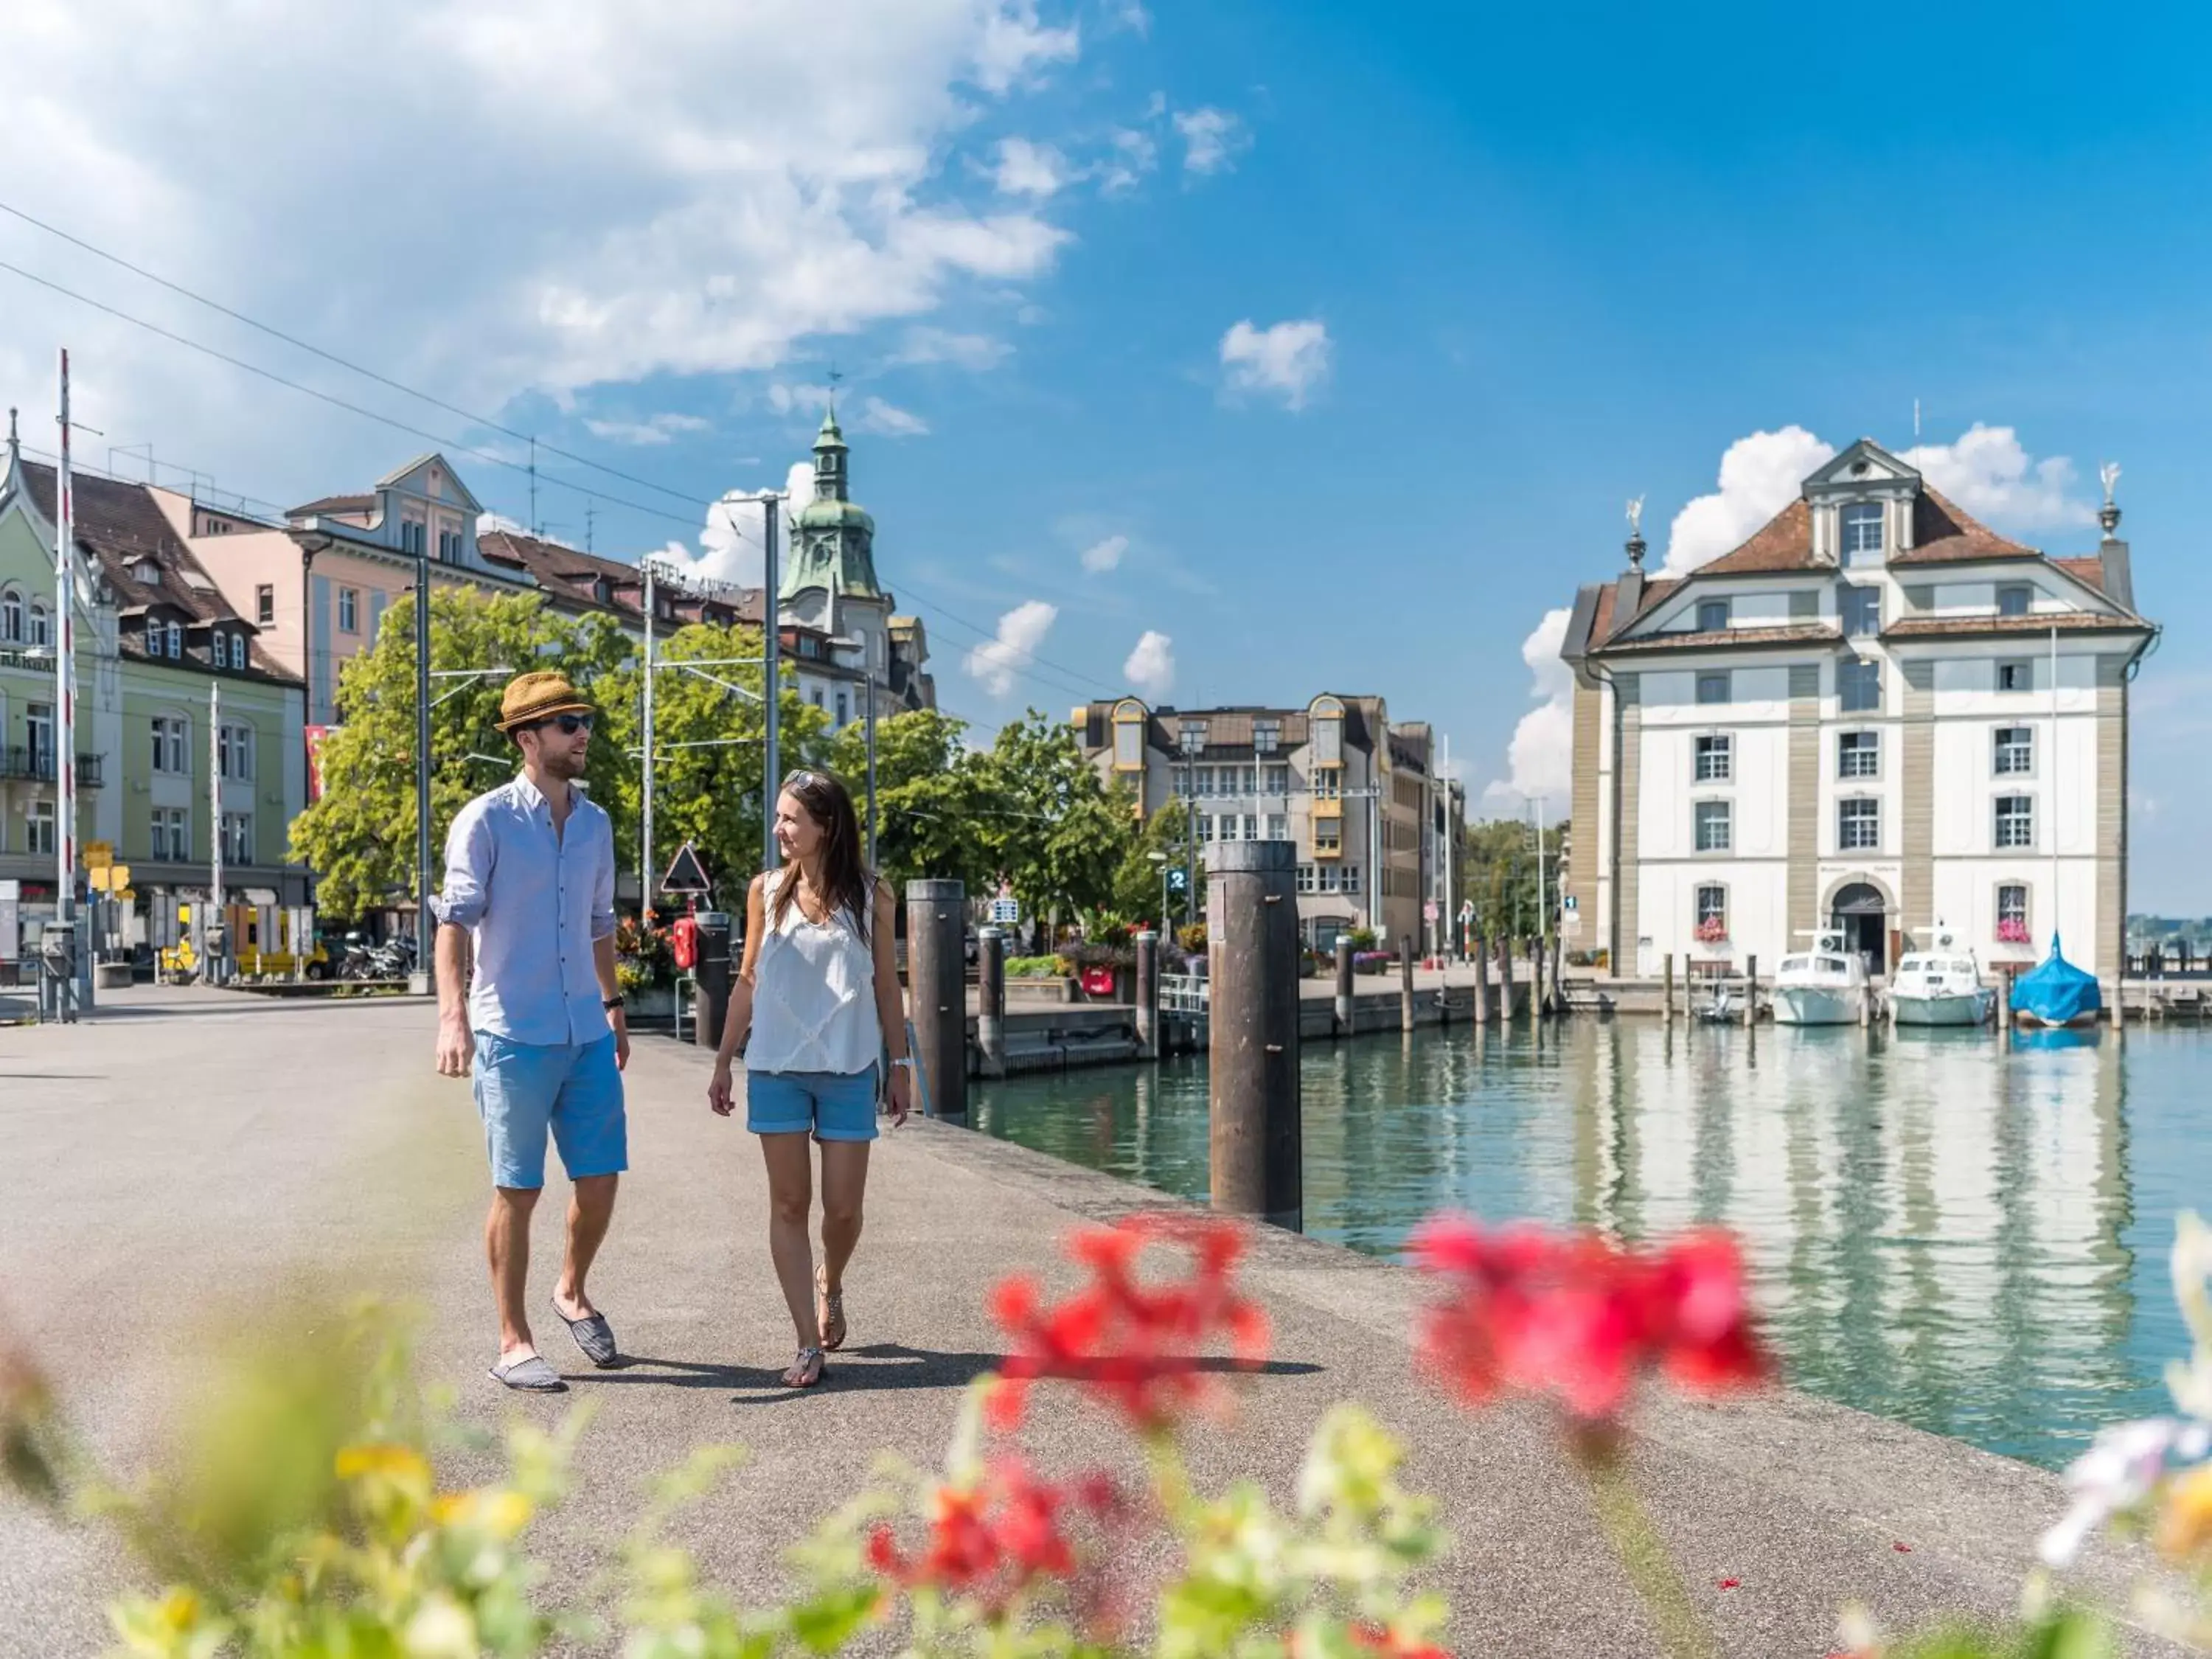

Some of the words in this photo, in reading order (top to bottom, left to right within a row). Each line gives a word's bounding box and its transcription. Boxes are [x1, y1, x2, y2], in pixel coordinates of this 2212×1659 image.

[639, 555, 681, 588] HOTEL
[698, 575, 741, 604] ANK
[1171, 872, 1184, 888] 2
[1567, 897, 1573, 908] 1
